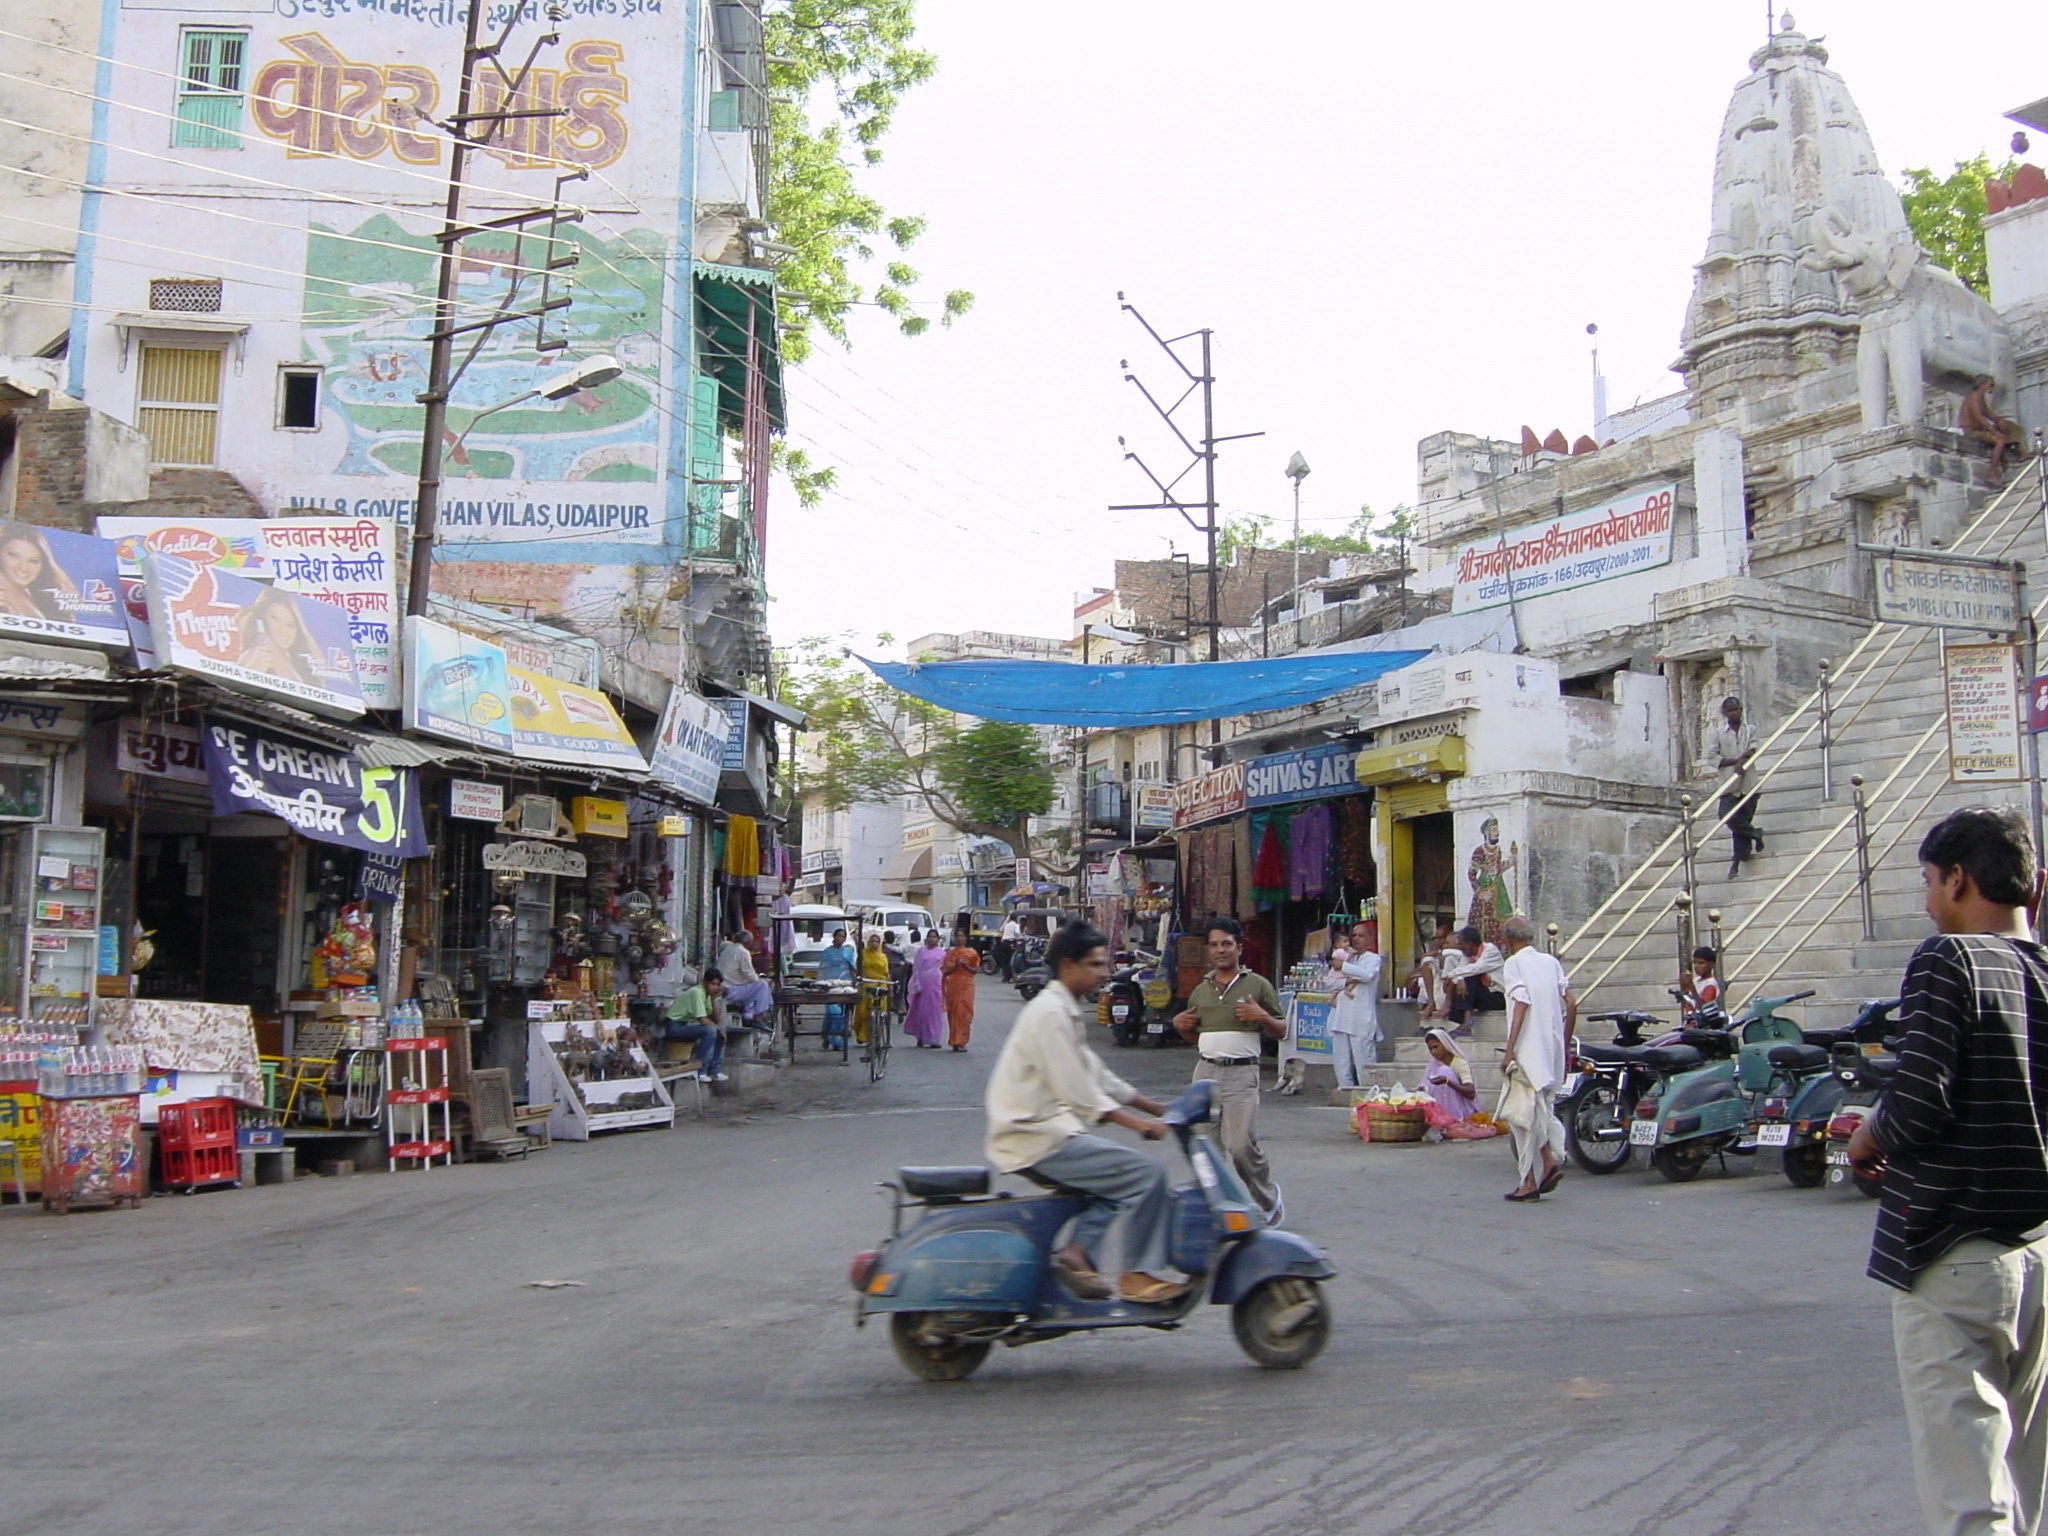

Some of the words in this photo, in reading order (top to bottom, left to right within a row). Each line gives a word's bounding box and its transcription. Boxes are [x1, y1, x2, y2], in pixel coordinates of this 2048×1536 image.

[252, 31, 441, 166] વોટર
[354, 497, 484, 527] GOVEHAN
[486, 502, 555, 533] VILAS,
[556, 503, 650, 529] UDAIPUR
[147, 530, 223, 558] Vadilal
[328, 519, 380, 552] स्मृति
[1457, 547, 1475, 585] श्री
[1567, 521, 1604, 555] मानव
[1602, 507, 1632, 547] सेवा
[1629, 490, 1673, 540] समिति
[284, 553, 329, 583] प्रदेश
[331, 551, 385, 582] केसरी
[58, 600, 114, 614] THUNDER
[346, 592, 388, 614] कुमार
[1908, 596, 1951, 618] PUBLIC
[2, 616, 86, 636] SONS
[347, 615, 389, 644] दंगल
[200, 659, 241, 678] SUDHA
[244, 668, 297, 693] SRINGAR
[299, 685, 337, 704] STORE
[522, 679, 548, 708] DAY
[514, 730, 546, 743] HAVE
[550, 737, 560, 748] A
[564, 737, 599, 752] GOOD
[256, 738, 355, 788] CREAM
[1954, 757, 1977, 767] CITY
[1979, 756, 2014, 767] PALACE
[1174, 763, 1245, 811] SELECTION
[1246, 760, 1317, 798] SHIVA'S
